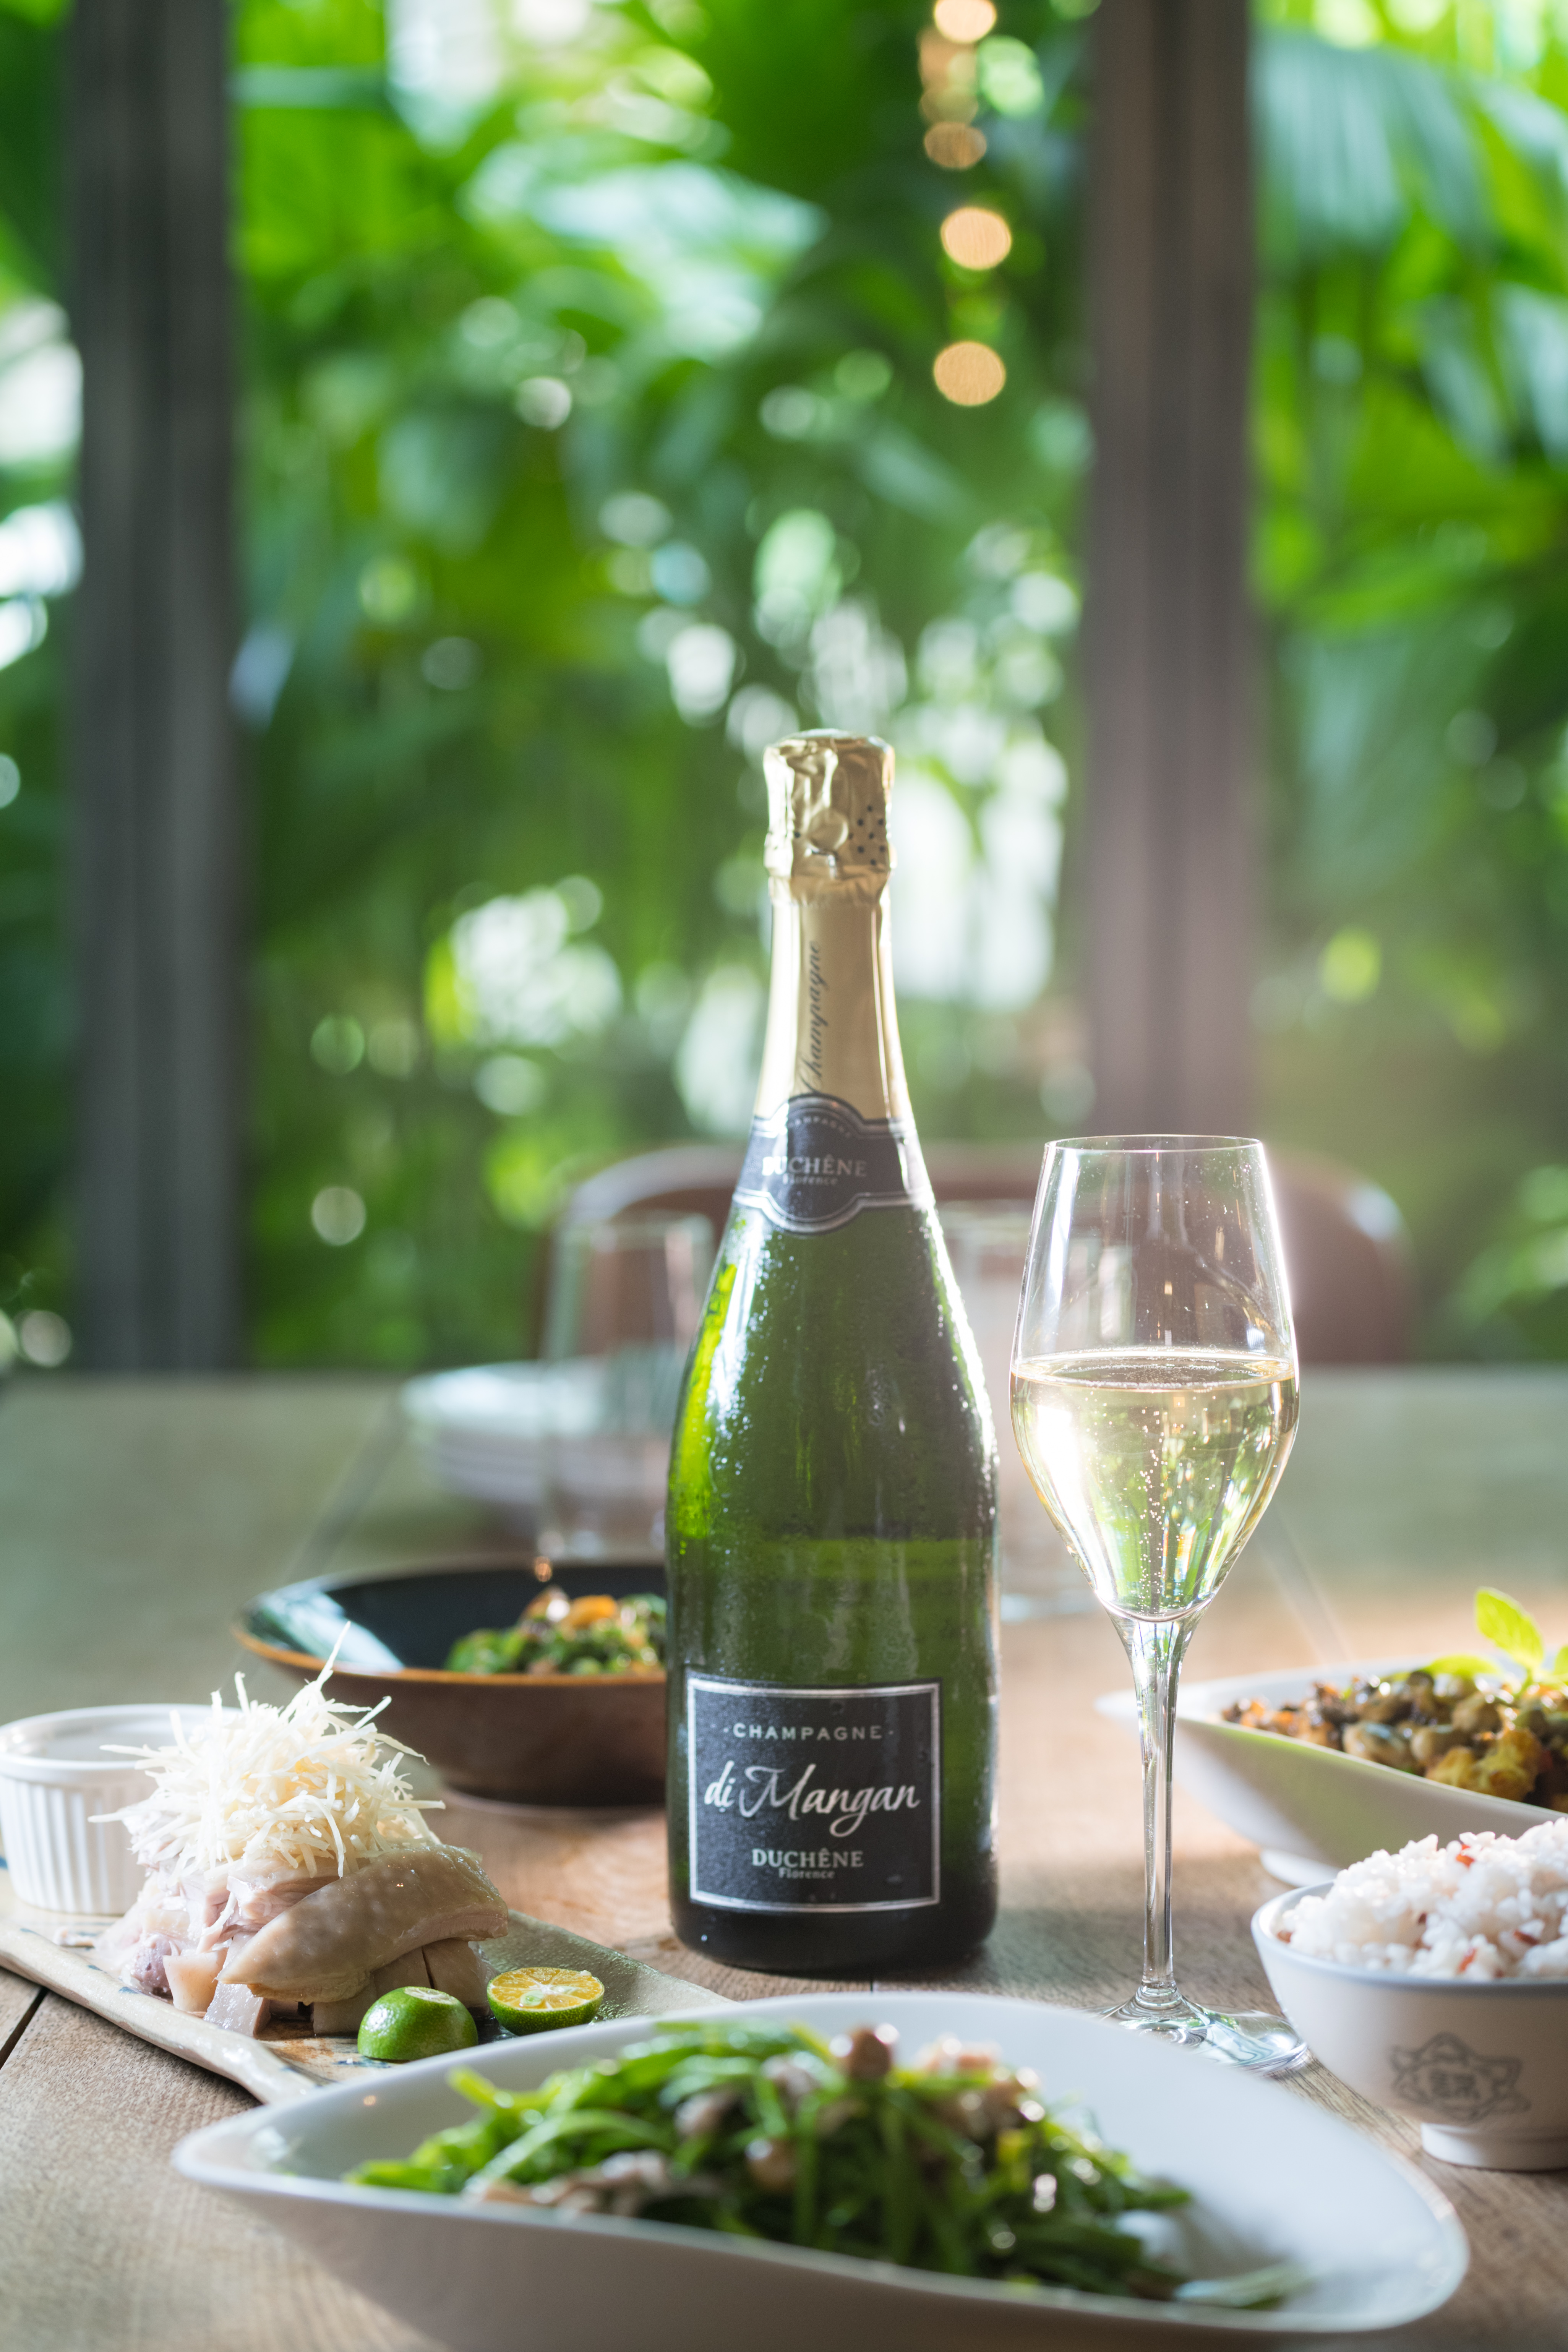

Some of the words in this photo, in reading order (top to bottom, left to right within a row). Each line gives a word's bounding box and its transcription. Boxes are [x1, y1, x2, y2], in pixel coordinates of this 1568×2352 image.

[798, 940, 829, 1094] Champagne
[762, 1153, 867, 1178] DUCHÊNE
[733, 1722, 882, 1741] CHAMPAGNE
[739, 1763, 921, 1837] Mangan
[752, 1847, 864, 1868] DUCHÊNE
[778, 1867, 835, 1879] Florence
